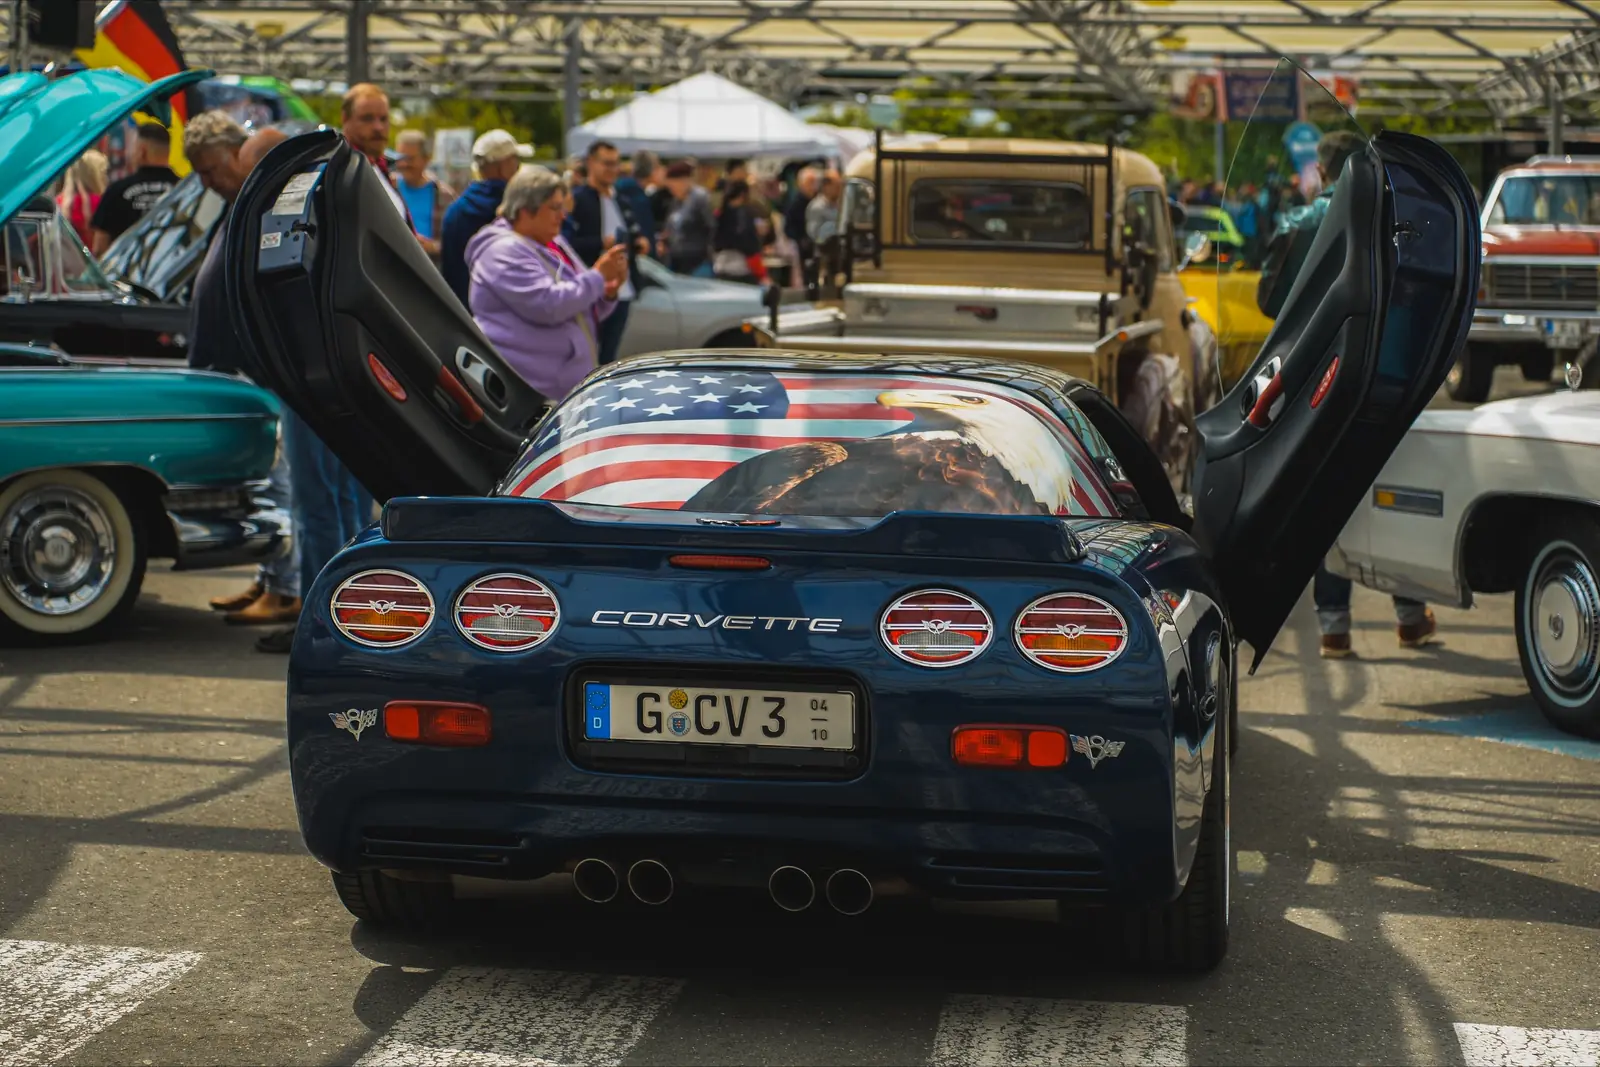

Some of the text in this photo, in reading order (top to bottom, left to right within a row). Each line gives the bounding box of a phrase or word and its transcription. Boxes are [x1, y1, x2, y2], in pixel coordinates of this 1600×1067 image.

[591, 610, 843, 632] CORVETTE
[810, 699, 828, 711] 04
[637, 692, 662, 734] G
[694, 694, 749, 737] CV
[762, 696, 785, 738] 3
[593, 717, 602, 729] D
[811, 728, 828, 741] 10
